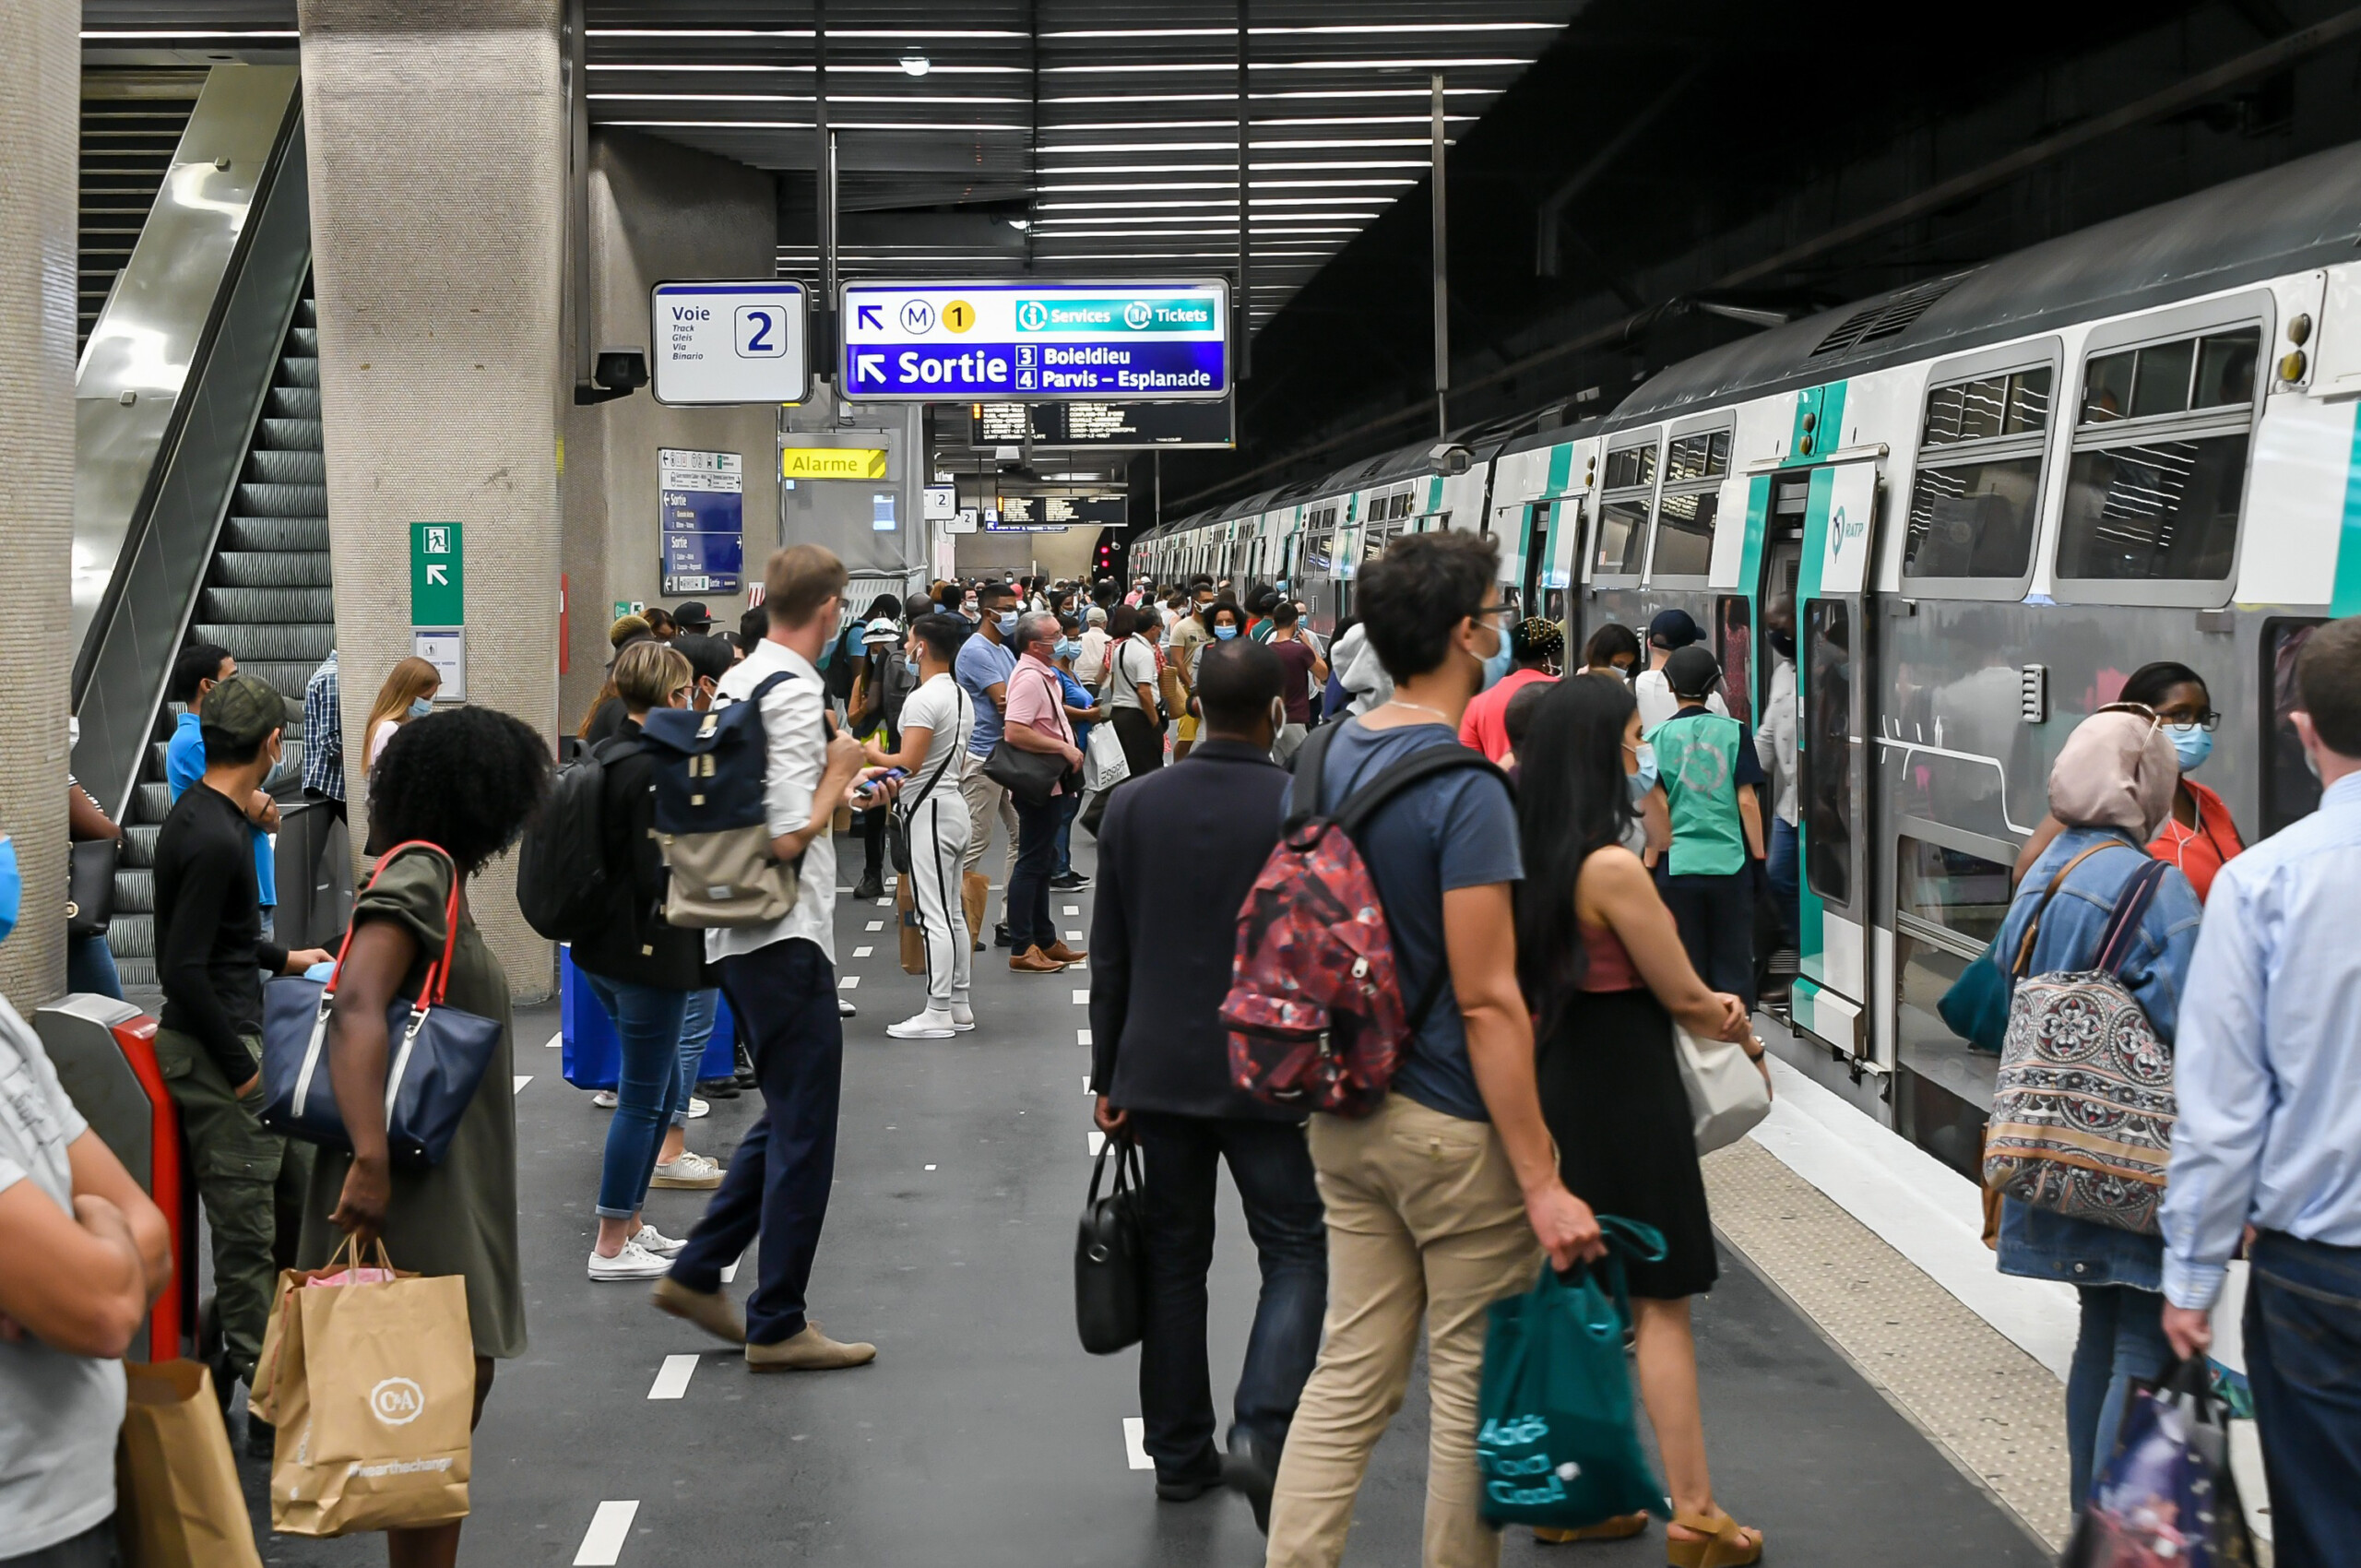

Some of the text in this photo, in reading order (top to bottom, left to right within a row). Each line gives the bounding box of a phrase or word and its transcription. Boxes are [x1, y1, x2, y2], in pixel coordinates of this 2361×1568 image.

[671, 306, 710, 321] Voie
[908, 307, 962, 327] M 1
[1050, 308, 1208, 324] Services Tickets
[672, 324, 694, 333] Track
[746, 312, 774, 351] 2
[672, 334, 693, 342] Gleis
[672, 343, 686, 351] Via
[672, 352, 704, 361] Binario
[1020, 347, 1131, 365] 3 Boieldieu
[898, 350, 1008, 384] Sortie
[1019, 371, 1033, 388] 4
[1042, 370, 1097, 388] Parvis
[1118, 370, 1211, 391] Esplanade
[791, 457, 858, 472] Alarme
[670, 494, 687, 506] Sortie
[938, 494, 946, 505] 2
[964, 514, 970, 523] 2
[1845, 522, 1864, 538] RATP
[671, 536, 688, 549] Sortie
